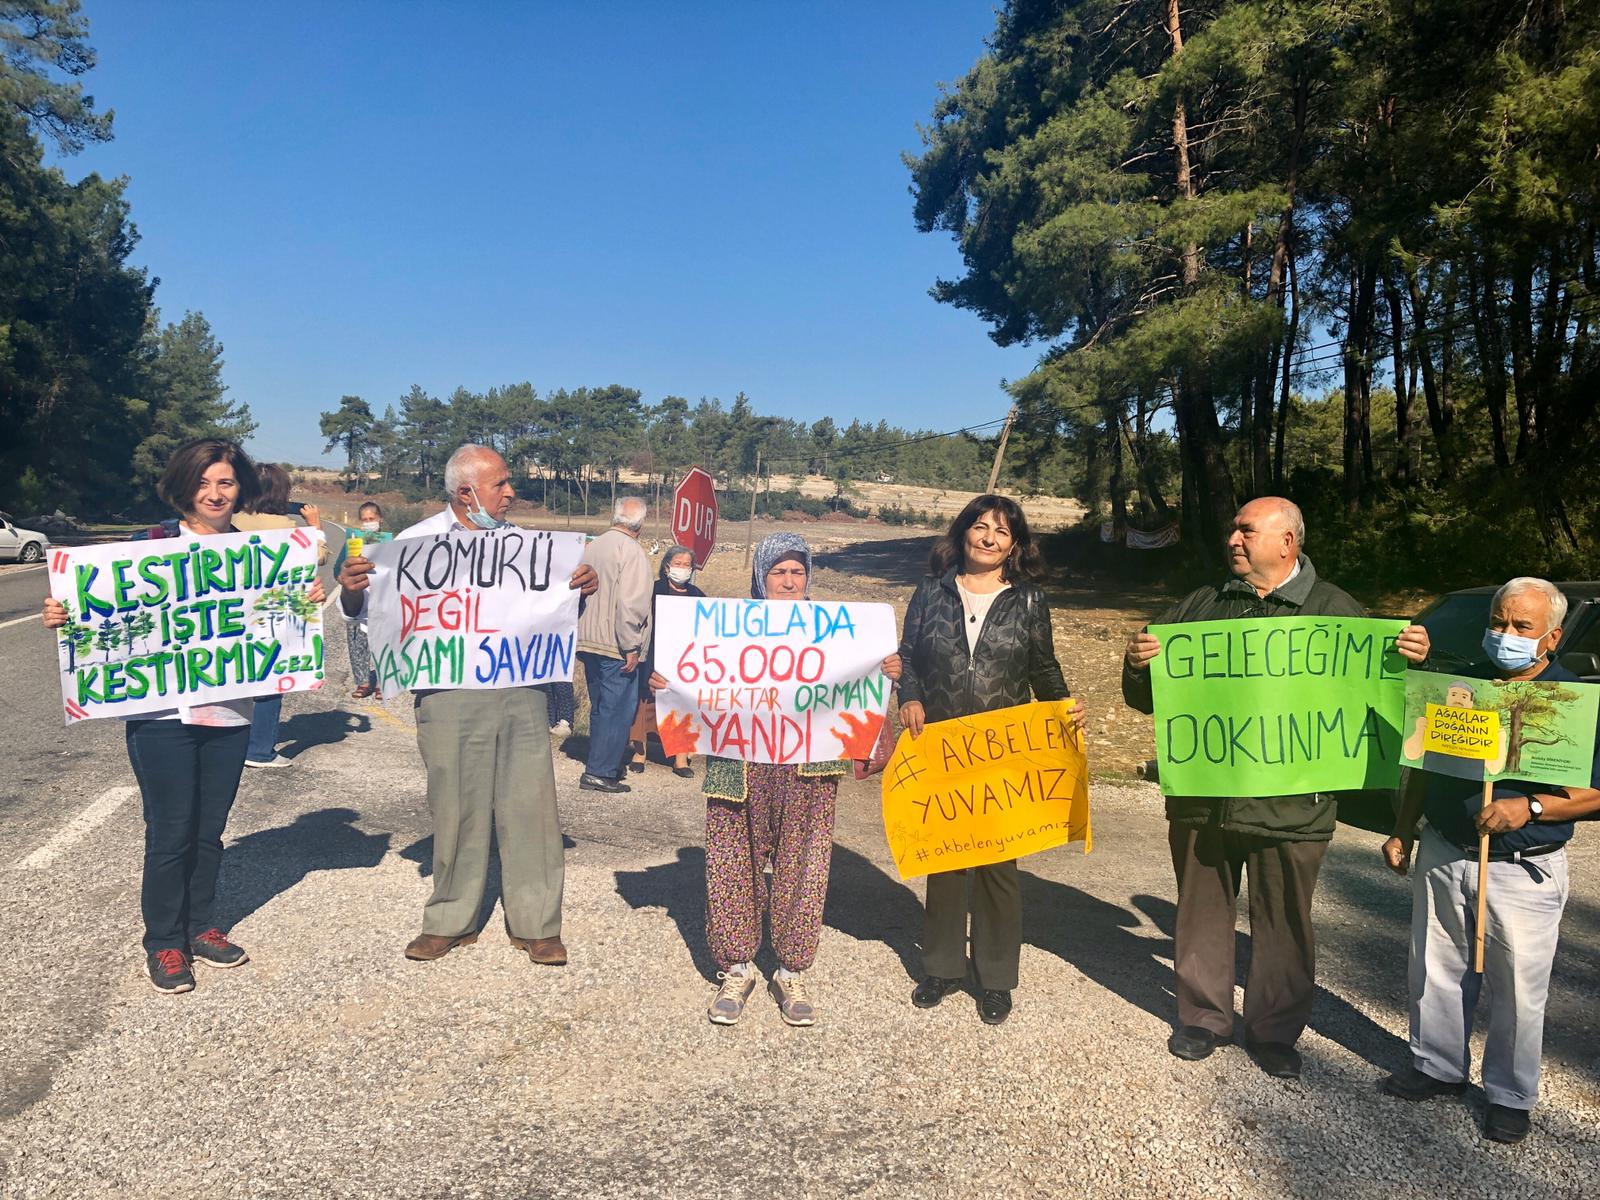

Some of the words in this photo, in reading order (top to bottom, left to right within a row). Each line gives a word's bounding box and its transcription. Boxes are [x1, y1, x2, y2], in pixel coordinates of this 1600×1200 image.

[678, 497, 713, 540] DUR
[397, 532, 553, 592] KÖMÜRÜ
[161, 598, 246, 646] İŞTE
[400, 588, 500, 643] DEĞİL
[694, 598, 856, 644] MUĞLA'DA
[371, 634, 464, 693] YAŞAMI
[476, 631, 574, 685] SAVUN
[677, 642, 825, 684] 65.000
[1166, 623, 1403, 680] GELECEĞİME
[697, 687, 781, 711] HEKTAR
[794, 672, 883, 713] ORMAN
[1435, 708, 1490, 724] AĞAÇLAR
[701, 710, 811, 763] YANDI
[1167, 702, 1386, 767] DOKUNMA
[912, 768, 1073, 824] YUVAMIZ
